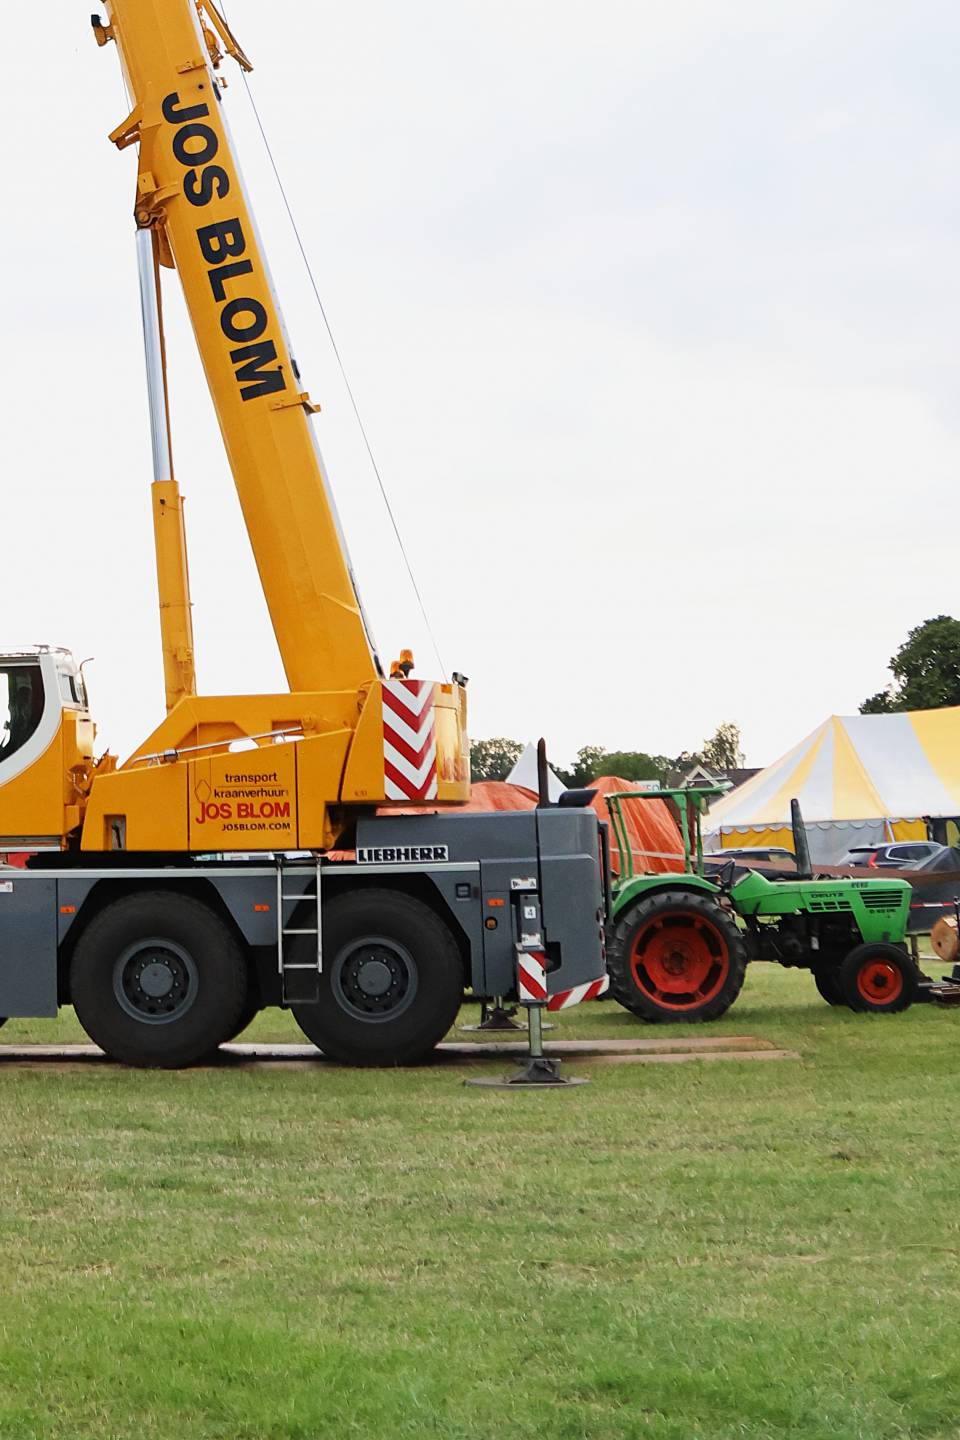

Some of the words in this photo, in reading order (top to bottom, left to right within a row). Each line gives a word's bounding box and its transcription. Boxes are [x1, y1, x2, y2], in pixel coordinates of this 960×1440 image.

[161, 92, 230, 207] JOS
[196, 217, 287, 401] BLOM
[225, 772, 278, 784] transport
[214, 788, 285, 799] kraanverhuur
[195, 801, 233, 824] JOS
[237, 801, 290, 819] BLOM
[221, 822, 291, 831] JOSBLOM.COM
[358, 846, 447, 862] LIEBHERR
